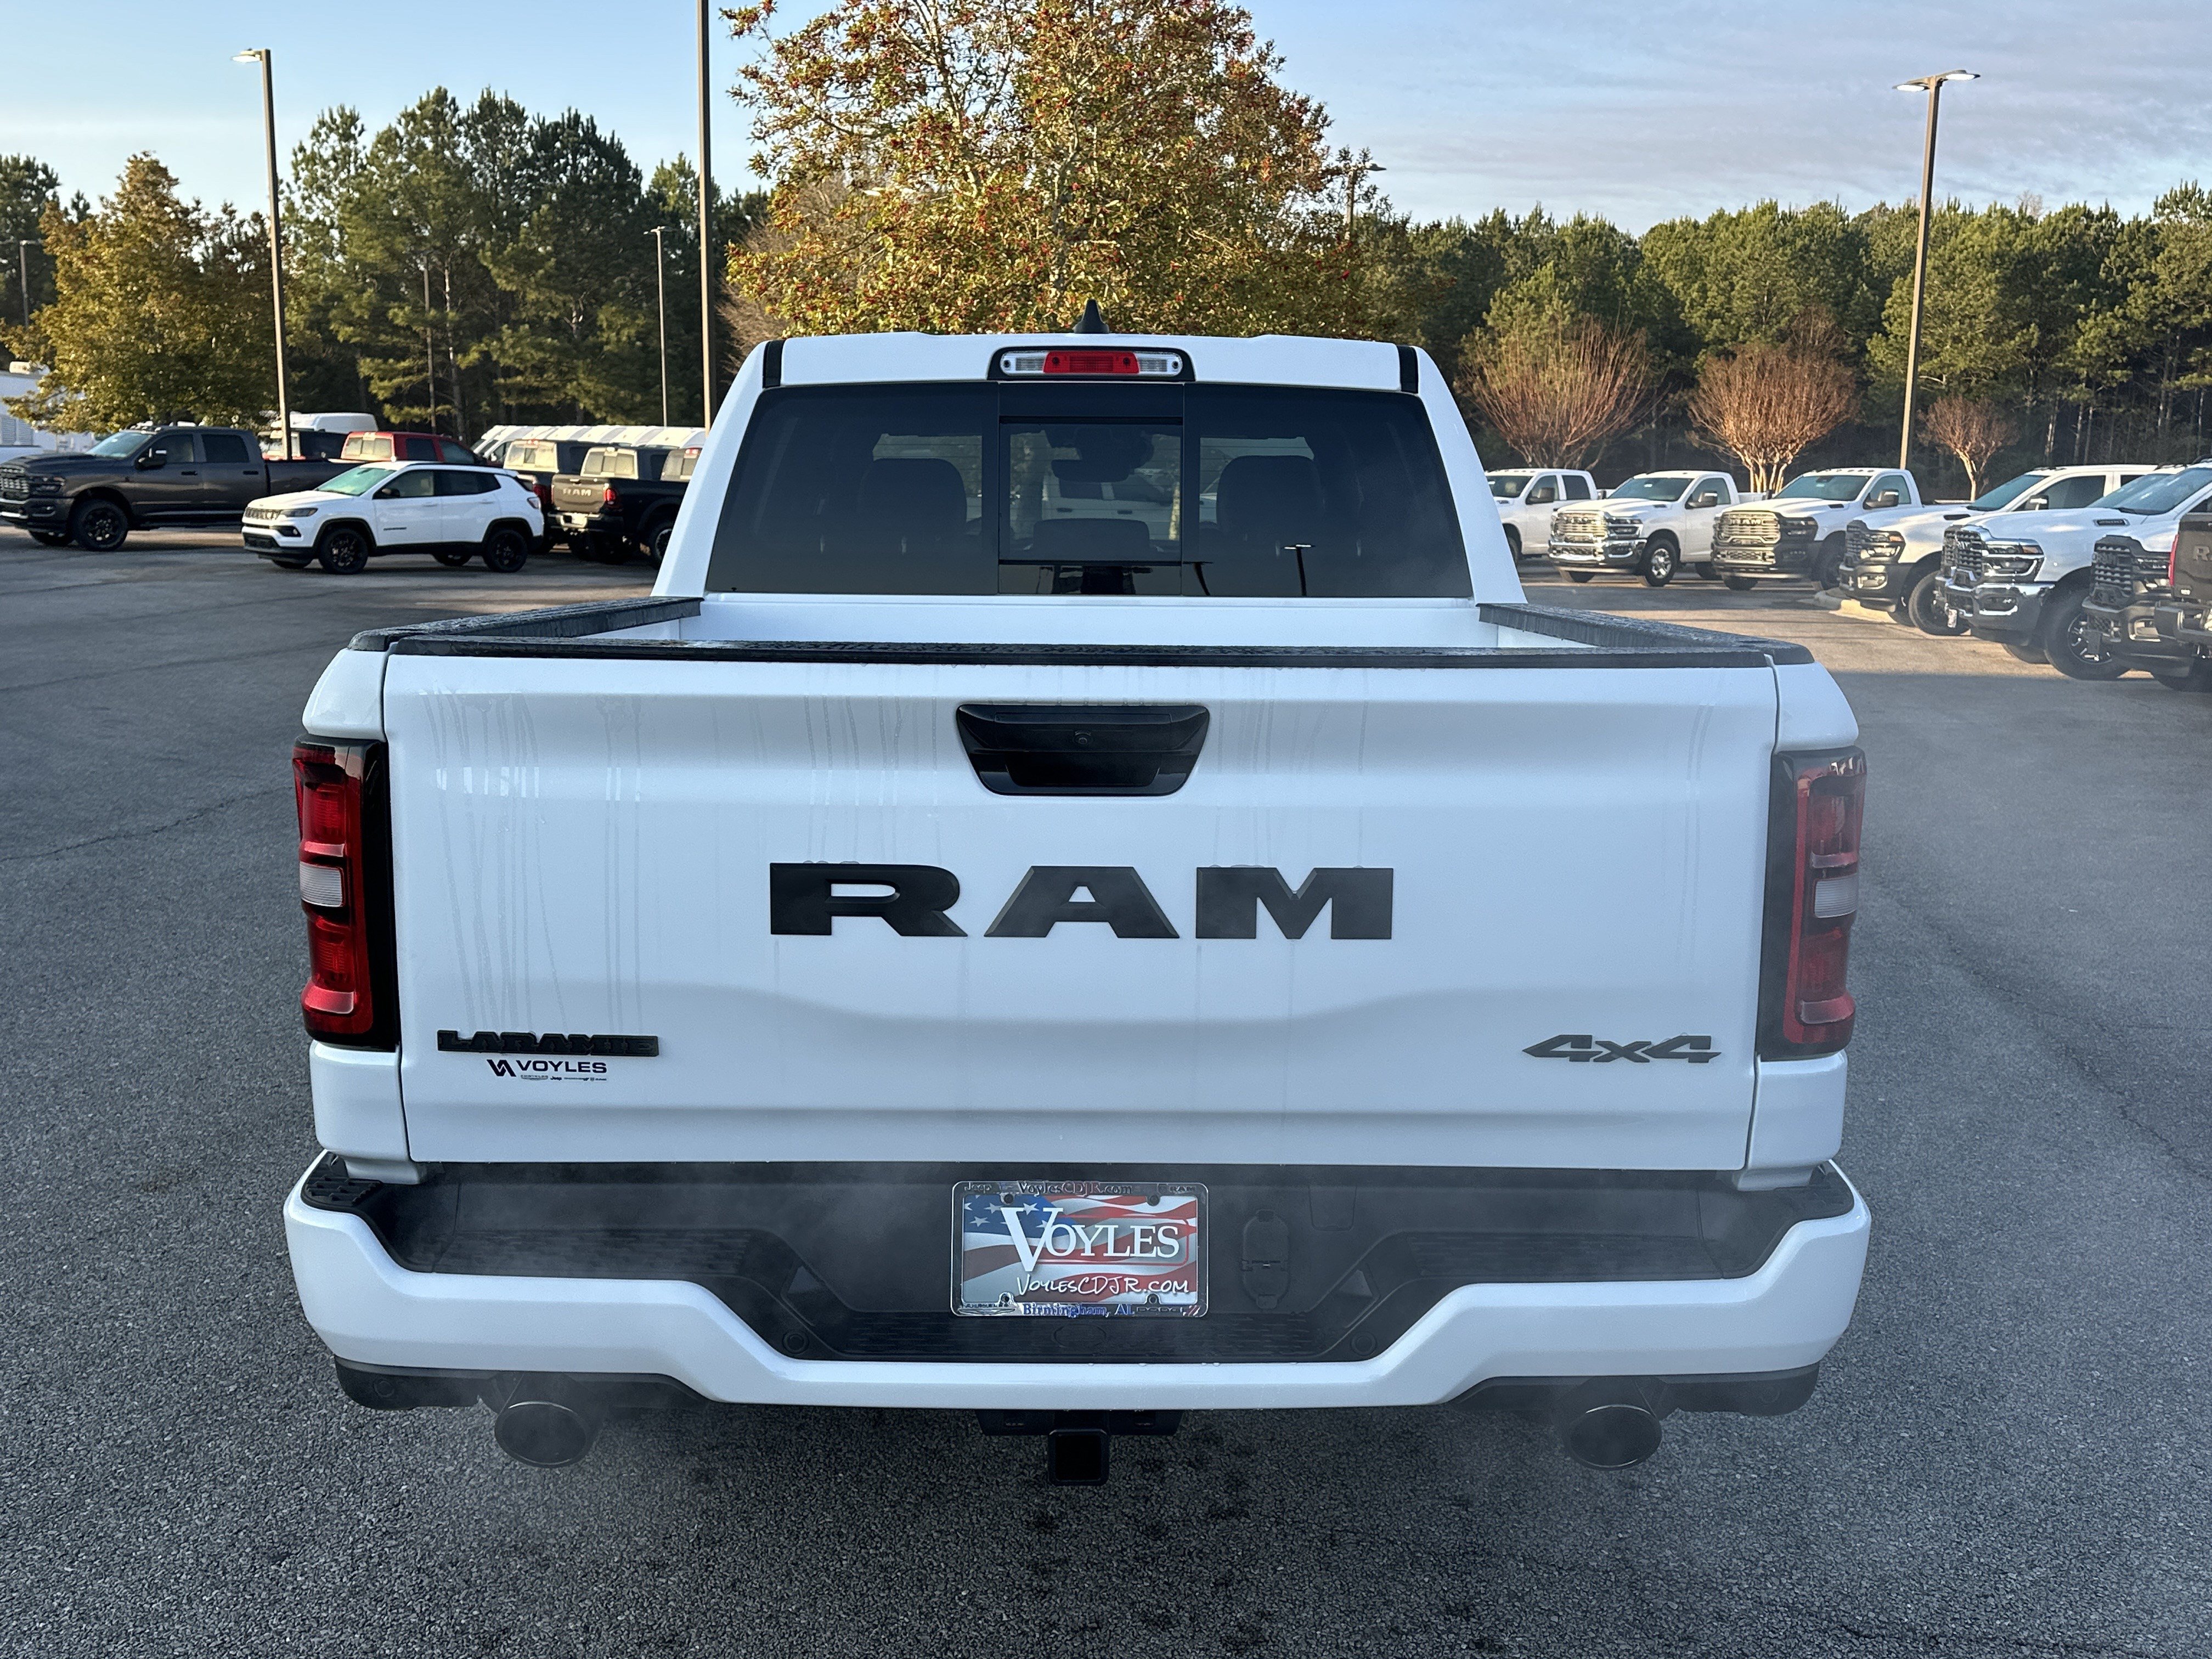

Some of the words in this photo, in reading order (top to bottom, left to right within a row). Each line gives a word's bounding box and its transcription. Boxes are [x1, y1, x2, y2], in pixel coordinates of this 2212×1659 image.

[770, 862, 1393, 940] RAM
[437, 1030, 659, 1057] LARAMIE
[516, 1060, 607, 1074] VOYLES
[964, 1182, 992, 1193] Jeep
[1000, 1207, 1180, 1272] VOYLES
